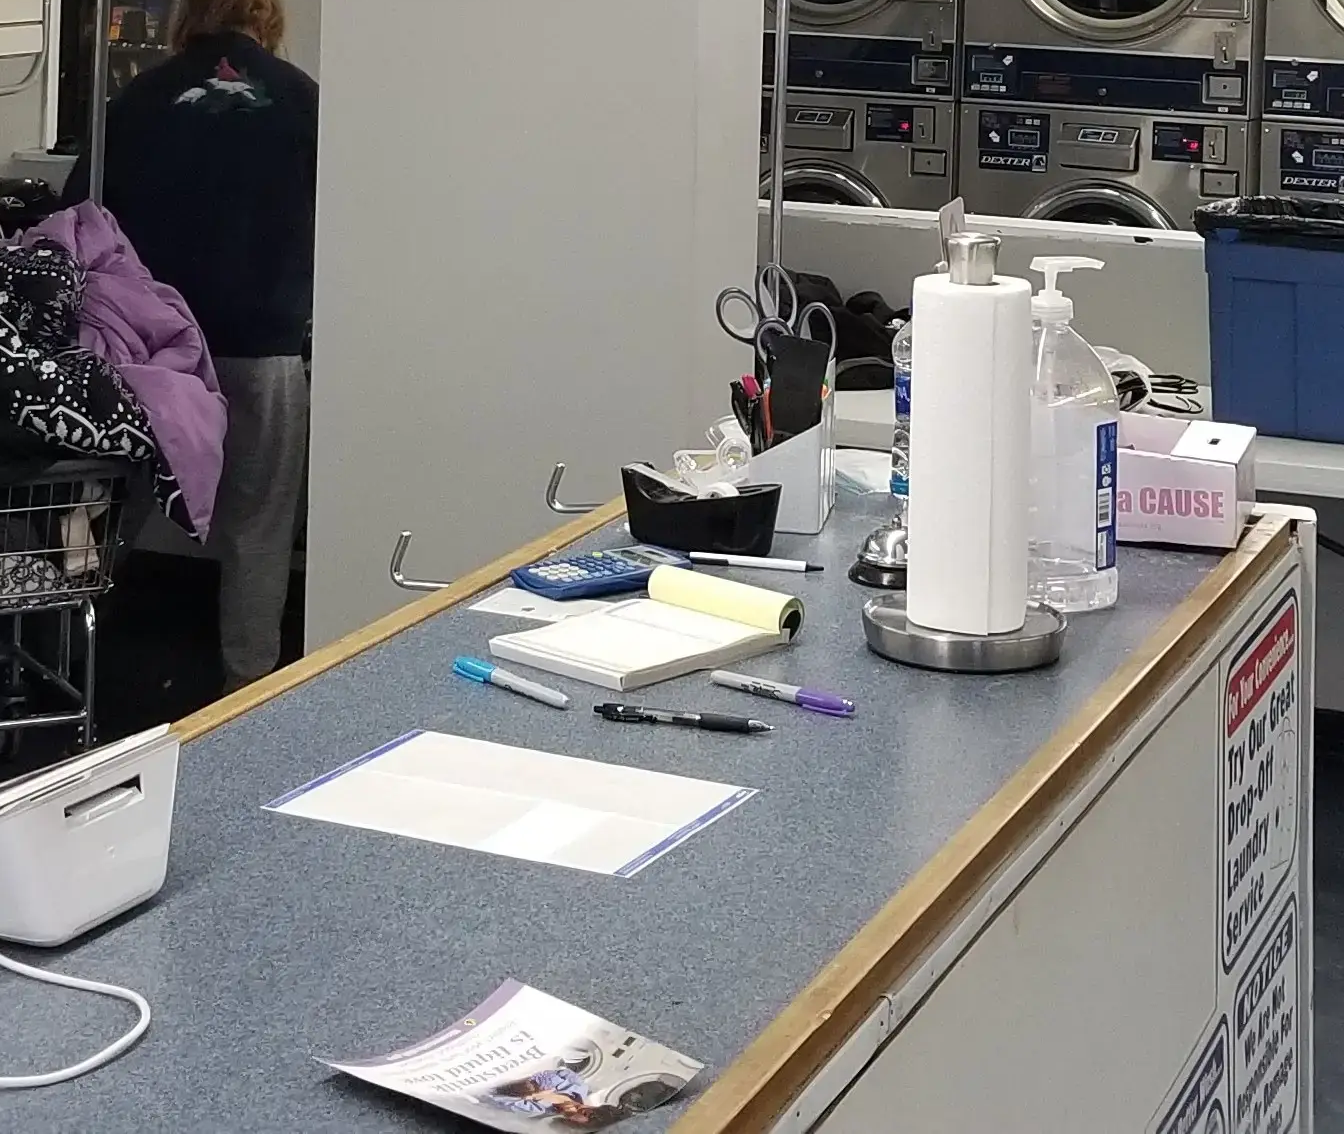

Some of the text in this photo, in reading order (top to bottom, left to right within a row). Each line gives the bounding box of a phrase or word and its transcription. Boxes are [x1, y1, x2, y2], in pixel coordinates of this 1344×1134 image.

[981, 155, 1031, 166] DEXTER
[1283, 176, 1338, 188] DEXTER
[1117, 487, 1224, 518] a CAUSE
[1229, 691, 1239, 725] For
[1240, 672, 1254, 708] Your
[1228, 670, 1294, 790] Try Our Great
[1228, 745, 1274, 845] Drop-Off
[1228, 812, 1269, 902] Laundry
[1227, 871, 1264, 956] Service
[1242, 928, 1290, 1026] NOTICE
[510, 1030, 534, 1044] is
[1245, 976, 1285, 1069] We Are Not
[1281, 1005, 1293, 1045] For
[432, 1045, 546, 1092] Breastmilk
[444, 1045, 513, 1078] liquid
